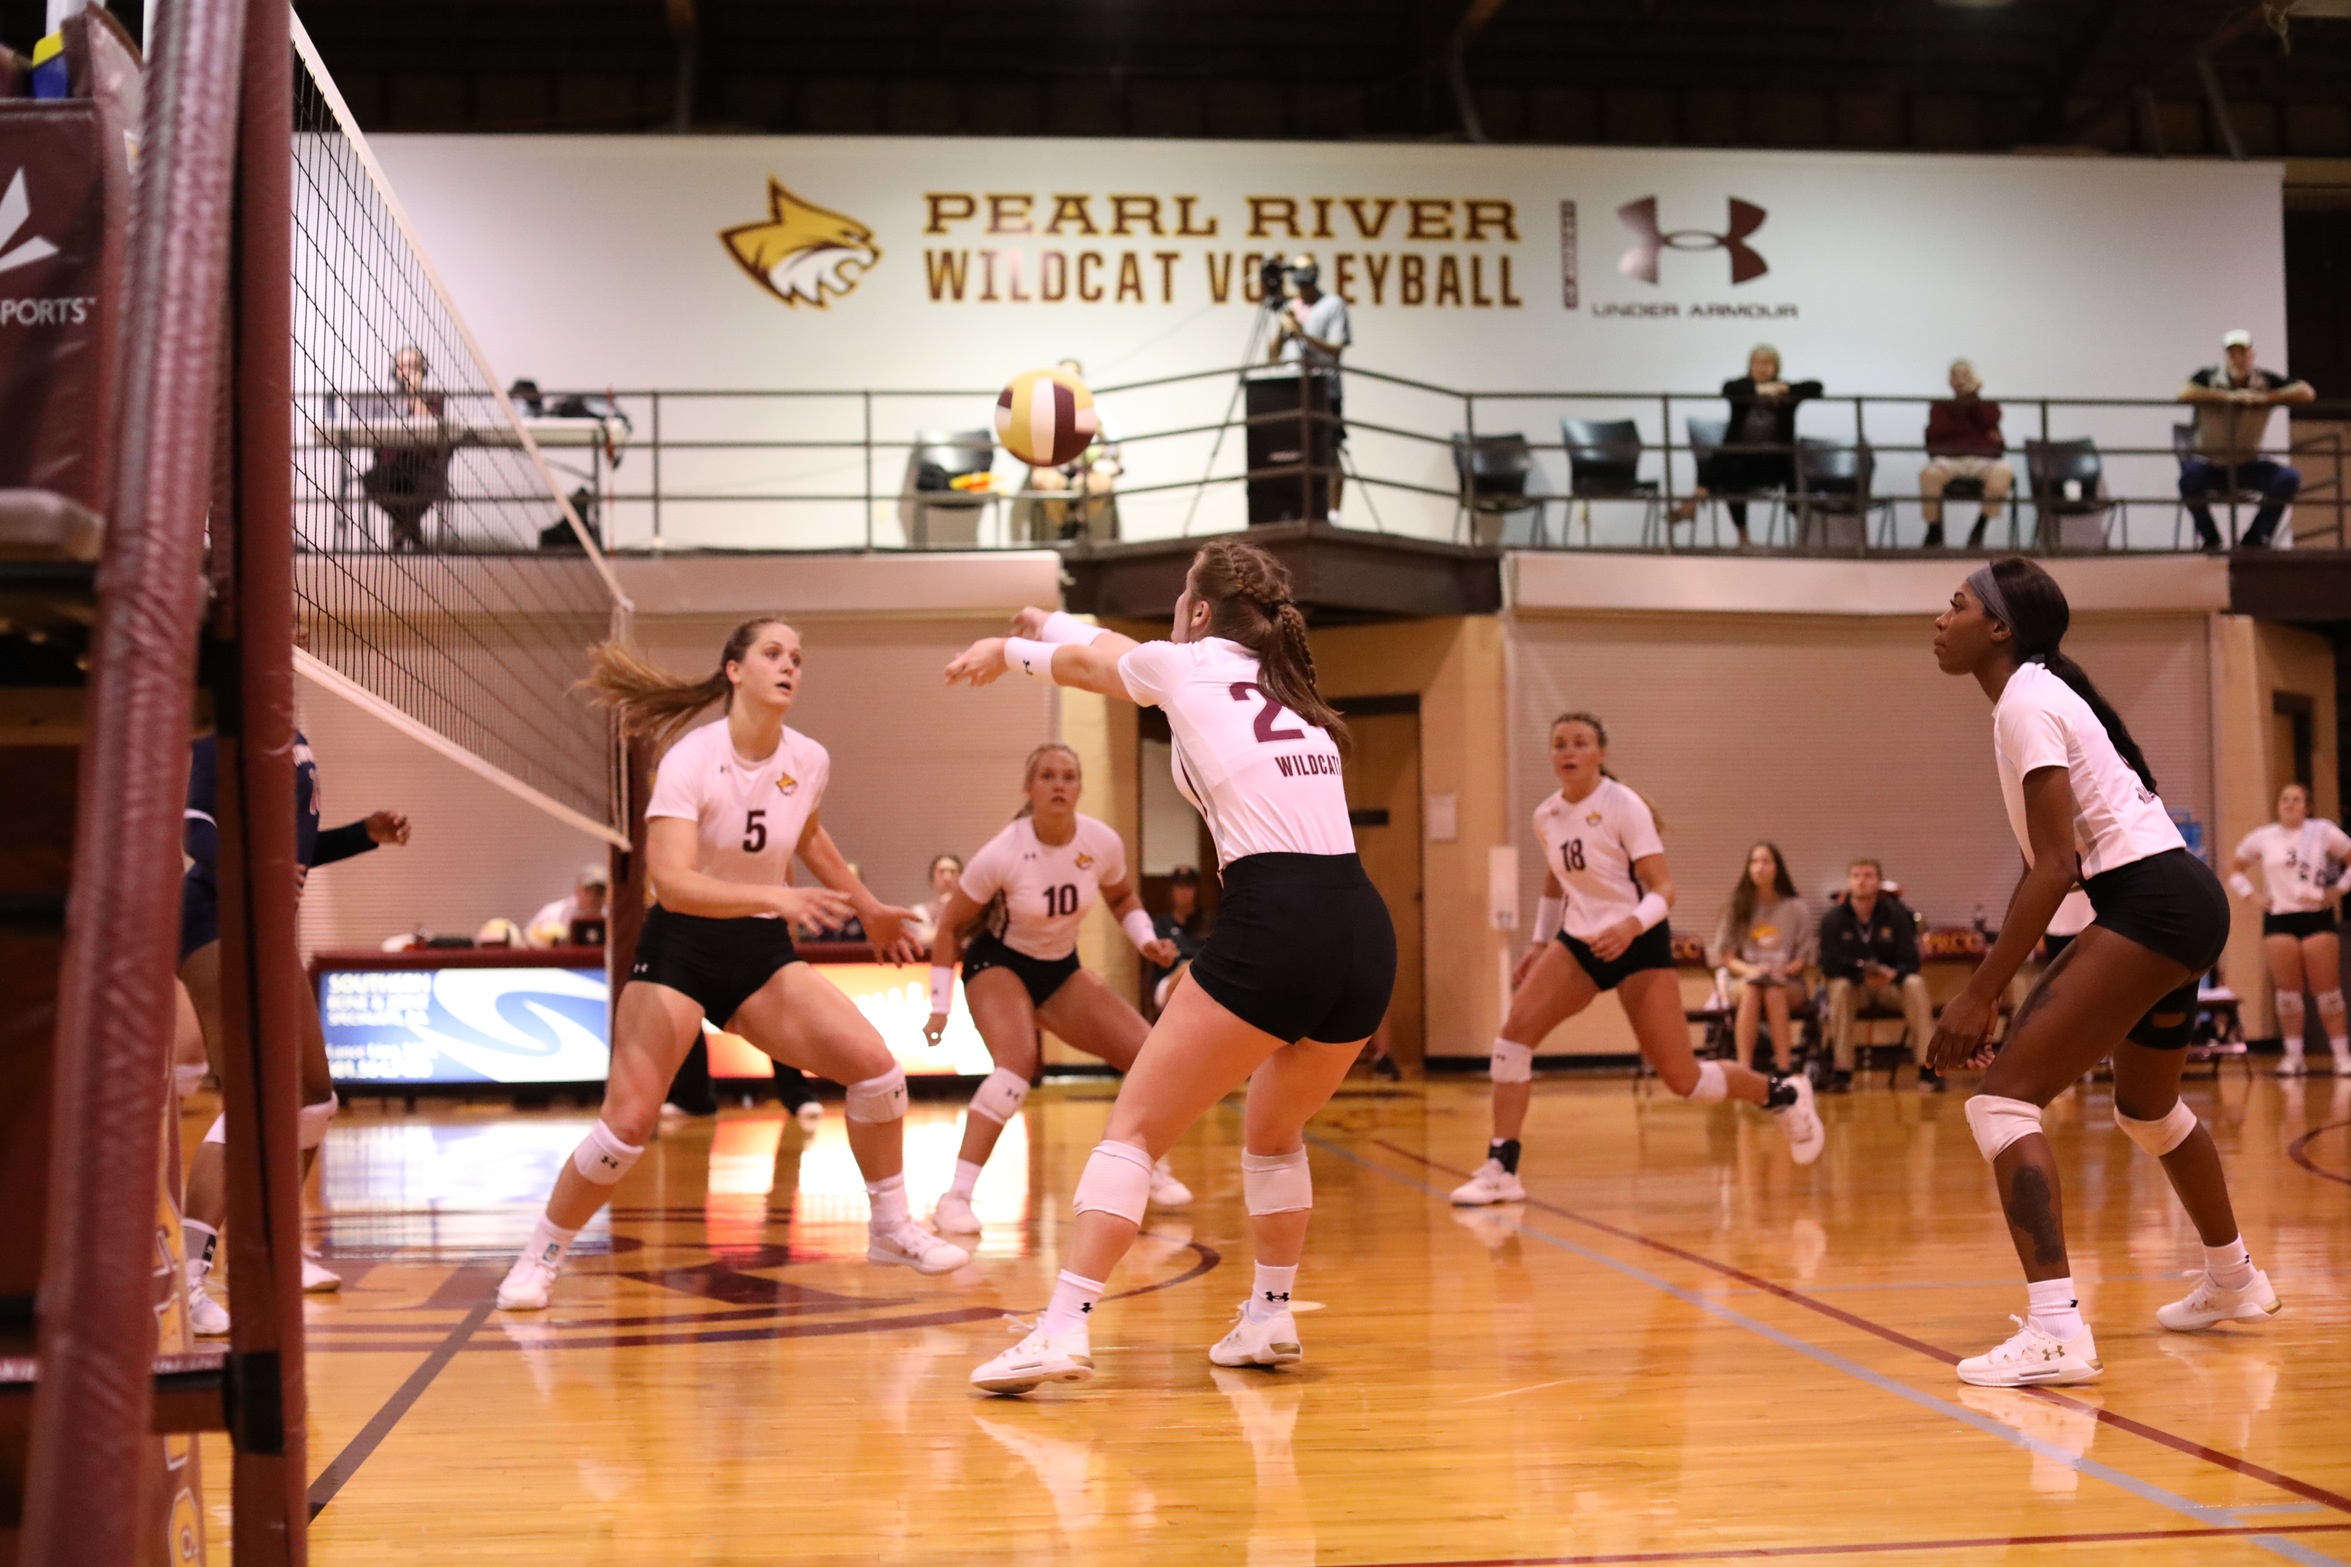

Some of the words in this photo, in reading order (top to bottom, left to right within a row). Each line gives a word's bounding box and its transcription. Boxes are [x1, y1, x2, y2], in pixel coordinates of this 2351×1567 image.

[921, 191, 1219, 240] PEARL
[1243, 194, 1522, 243] RIVER
[921, 248, 1184, 305] WILDCAT
[1205, 249, 1523, 308] VOEYBALL
[1592, 303, 1680, 318] UNDER
[1687, 303, 1799, 319] ARMOUR
[1229, 681, 1306, 743] 2
[742, 810, 767, 853] 5
[1560, 838, 1586, 872] 18
[1043, 884, 1078, 918] 10
